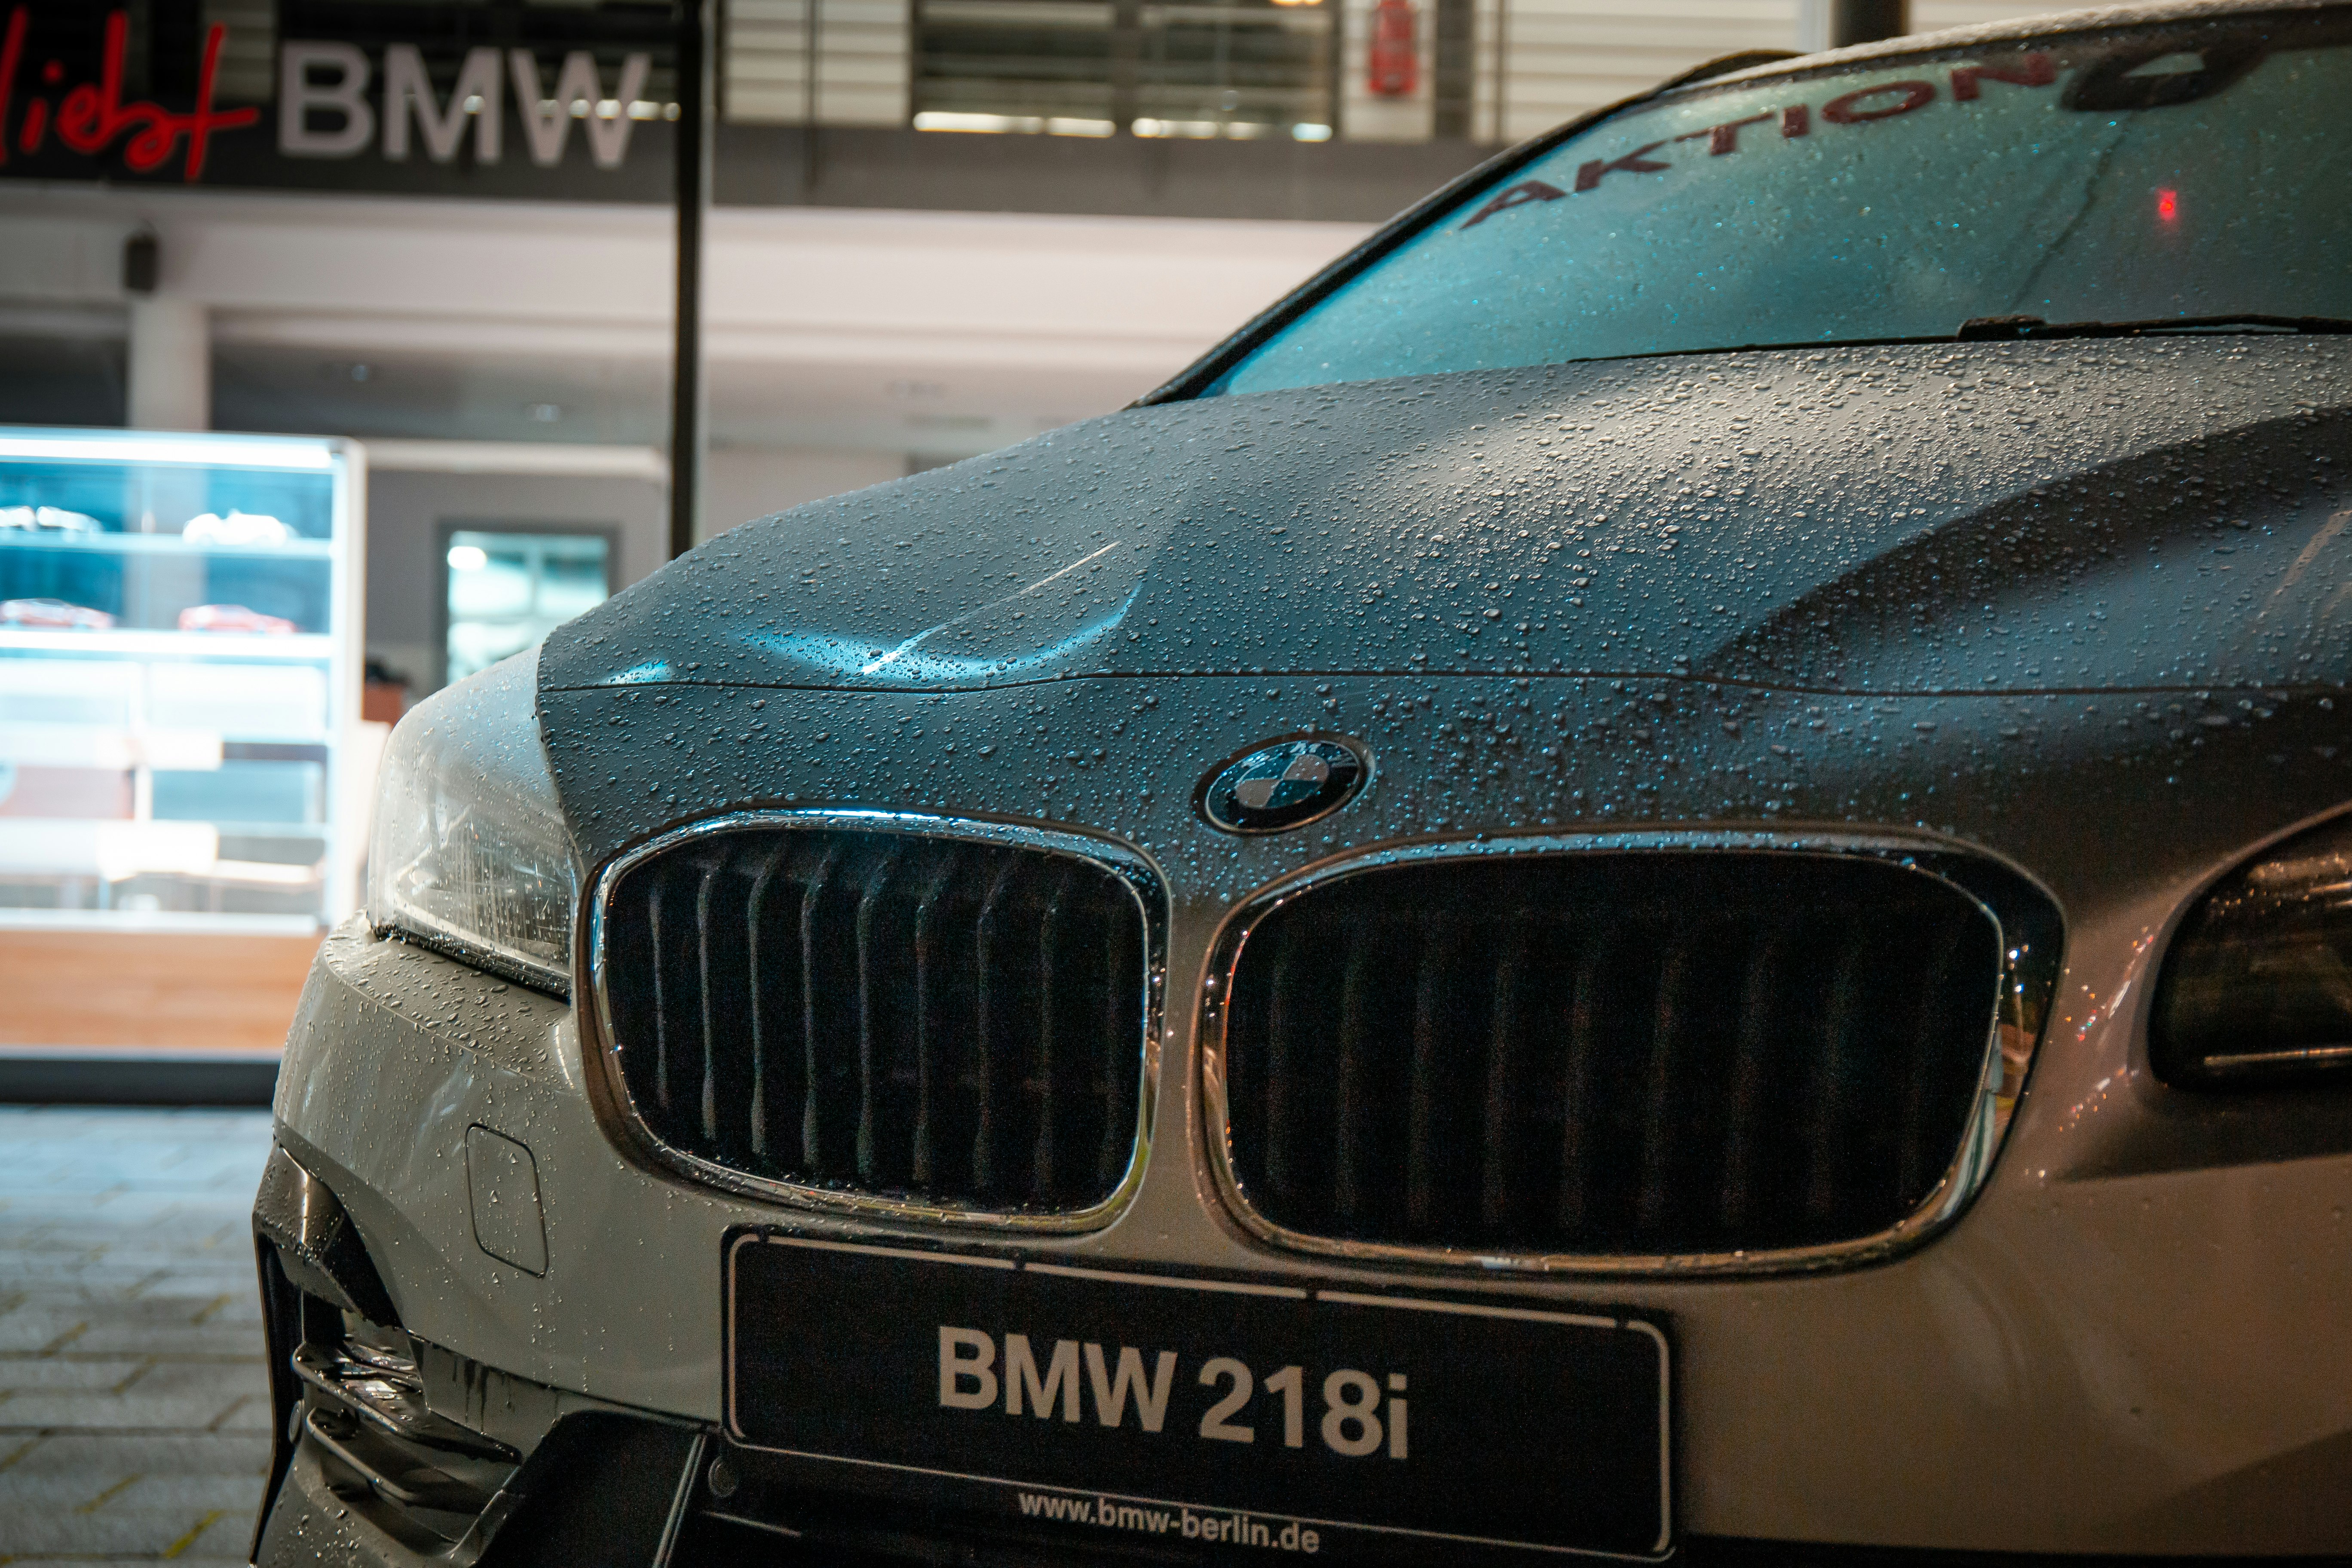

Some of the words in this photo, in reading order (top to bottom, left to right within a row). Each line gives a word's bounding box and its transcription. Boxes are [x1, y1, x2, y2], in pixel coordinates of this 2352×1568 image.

[279, 41, 651, 168] BMW
[1458, 52, 2056, 229] AKTION
[940, 1326, 1178, 1432] BMW
[1199, 1357, 1407, 1459] 218i
[1018, 1492, 1320, 1553] www.bmw-berlin.de
